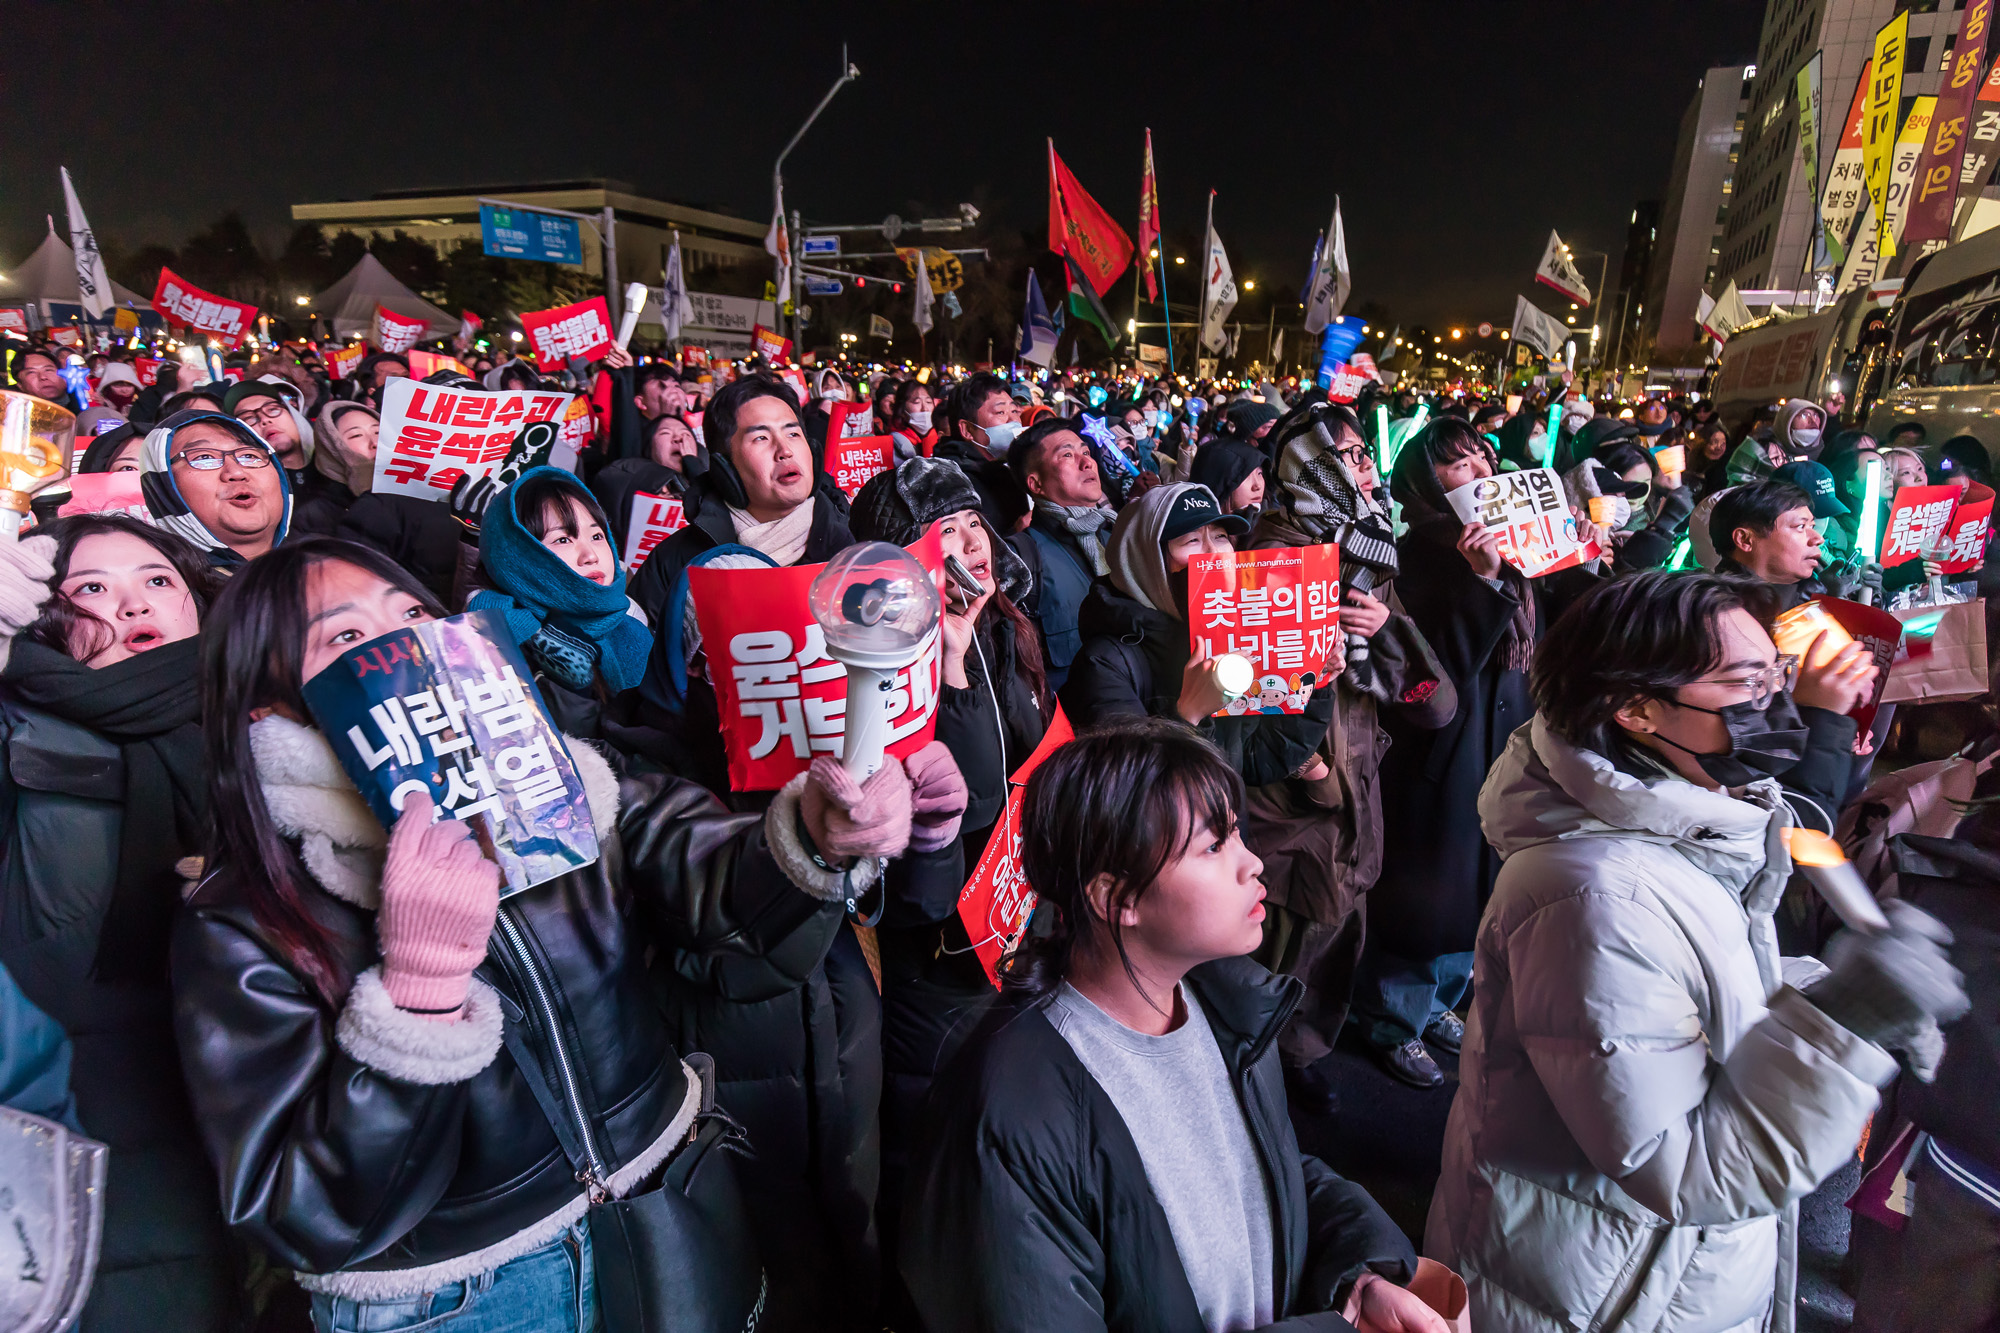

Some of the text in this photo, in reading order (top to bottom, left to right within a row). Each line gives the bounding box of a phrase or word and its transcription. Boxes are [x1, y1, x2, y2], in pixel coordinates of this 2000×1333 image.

[533, 309, 600, 350] 윤석열을
[540, 324, 609, 363] 거부한다!
[405, 388, 565, 428] 내란수괴
[394, 425, 516, 464] 윤석열
[841, 448, 883, 467] 내란수괴
[837, 467, 872, 487] 윤석열
[1183, 497, 1211, 511] Nice
[1473, 469, 1561, 527] 윤석열
[1892, 498, 1954, 533] 윤석열을
[1196, 558, 1302, 571] 나눔문화 www.nanum.com
[1202, 583, 1303, 629] 촛불의
[347, 664, 537, 771] 내란범
[961, 863, 986, 902] 나눔문화
